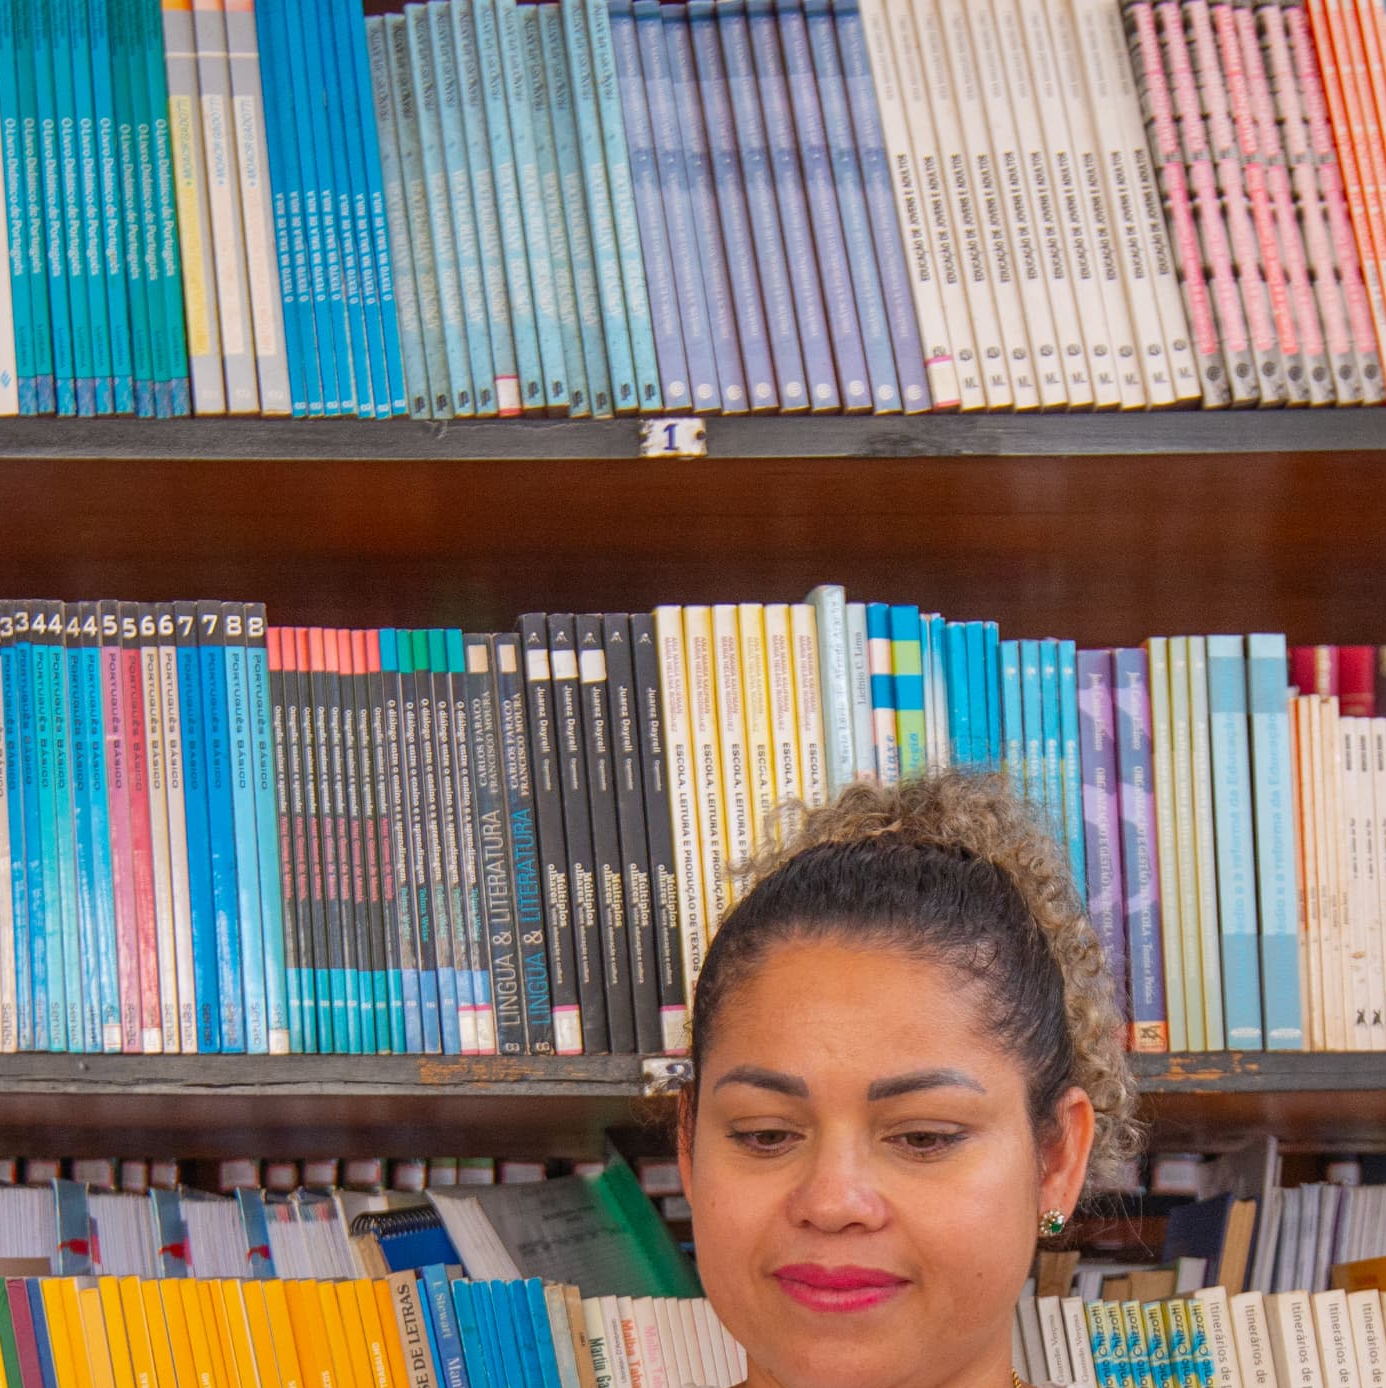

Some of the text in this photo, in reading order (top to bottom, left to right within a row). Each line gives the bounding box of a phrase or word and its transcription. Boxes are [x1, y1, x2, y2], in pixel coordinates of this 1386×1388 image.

[924, 155, 939, 190] ADULTOS
[932, 200, 946, 227] JOVENS
[939, 242, 958, 284] EDUCAÇÃO
[662, 423, 679, 450] 1
[0, 616, 13, 636] 3
[15, 611, 30, 632] 3
[31, 613, 47, 634] 4
[48, 613, 62, 636] 4
[66, 617, 81, 637] 4
[83, 615, 98, 635] 4
[102, 615, 118, 635] 5
[122, 617, 137, 638] 5
[141, 615, 154, 636] 6
[159, 615, 174, 635] 6
[178, 615, 194, 637] 7
[201, 614, 218, 635] 7
[226, 615, 242, 636] 8
[248, 617, 264, 637] 8
[146, 653, 162, 789] PORTUGUÊS BÁSICO
[591, 686, 607, 752] Juarez Dayrell
[481, 809, 520, 1026] LINGUA & LITERATURA
[397, 1282, 421, 1345] LETRAS
[1189, 1303, 1209, 1353] Chizzotti
[588, 1336, 609, 1371] Martin
[1326, 1302, 1348, 1365] Itinerários
[1337, 1368, 1351, 1384] de
[410, 1347, 426, 1370] DE
